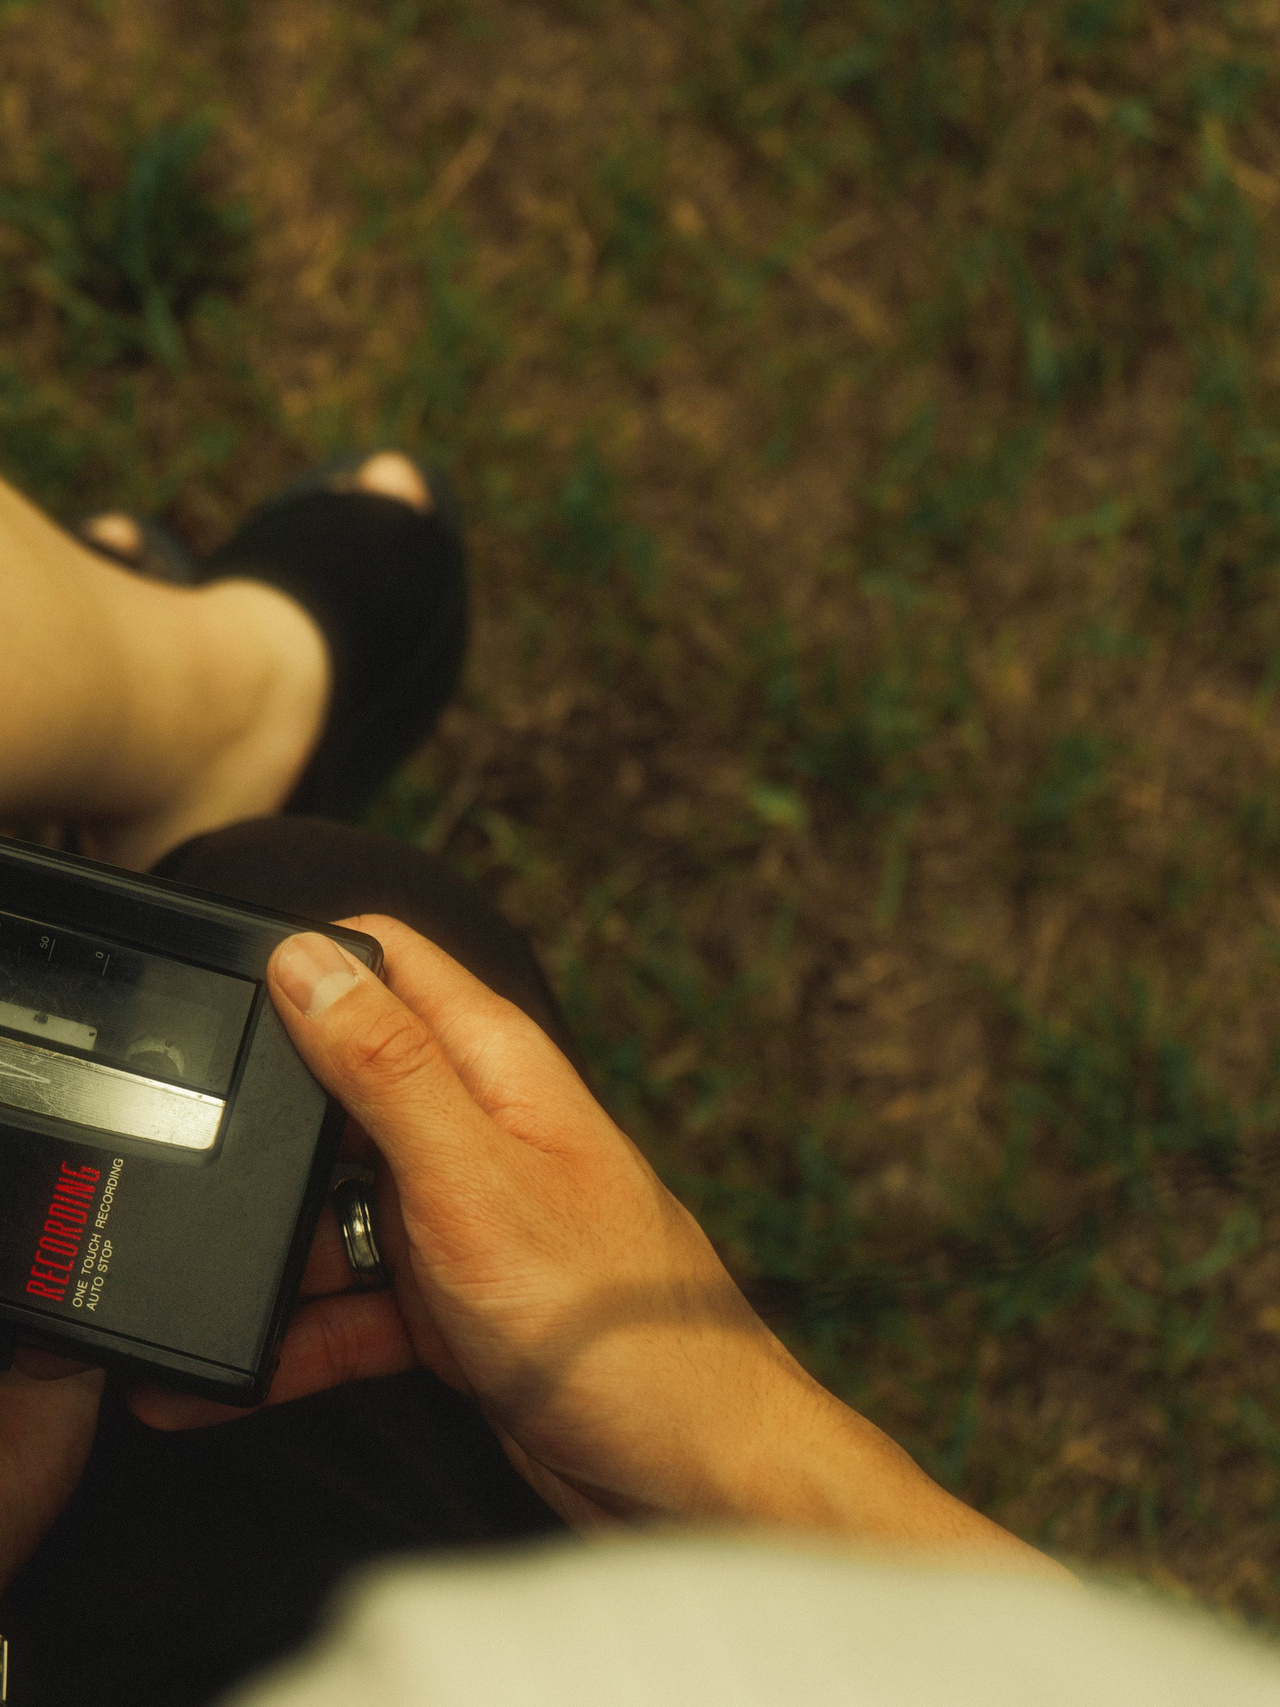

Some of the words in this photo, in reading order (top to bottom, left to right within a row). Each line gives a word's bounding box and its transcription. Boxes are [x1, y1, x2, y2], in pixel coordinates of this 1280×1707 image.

[39, 935, 50, 949] 50
[95, 951, 104, 959] 0
[95, 1157, 124, 1229] RECORDING
[26, 1161, 100, 1302] RECORDING
[80, 1233, 102, 1275] TOUCH
[86, 1276, 104, 1311] AUTO
[97, 1239, 113, 1273] STOP
[72, 1279, 89, 1308] ONE
